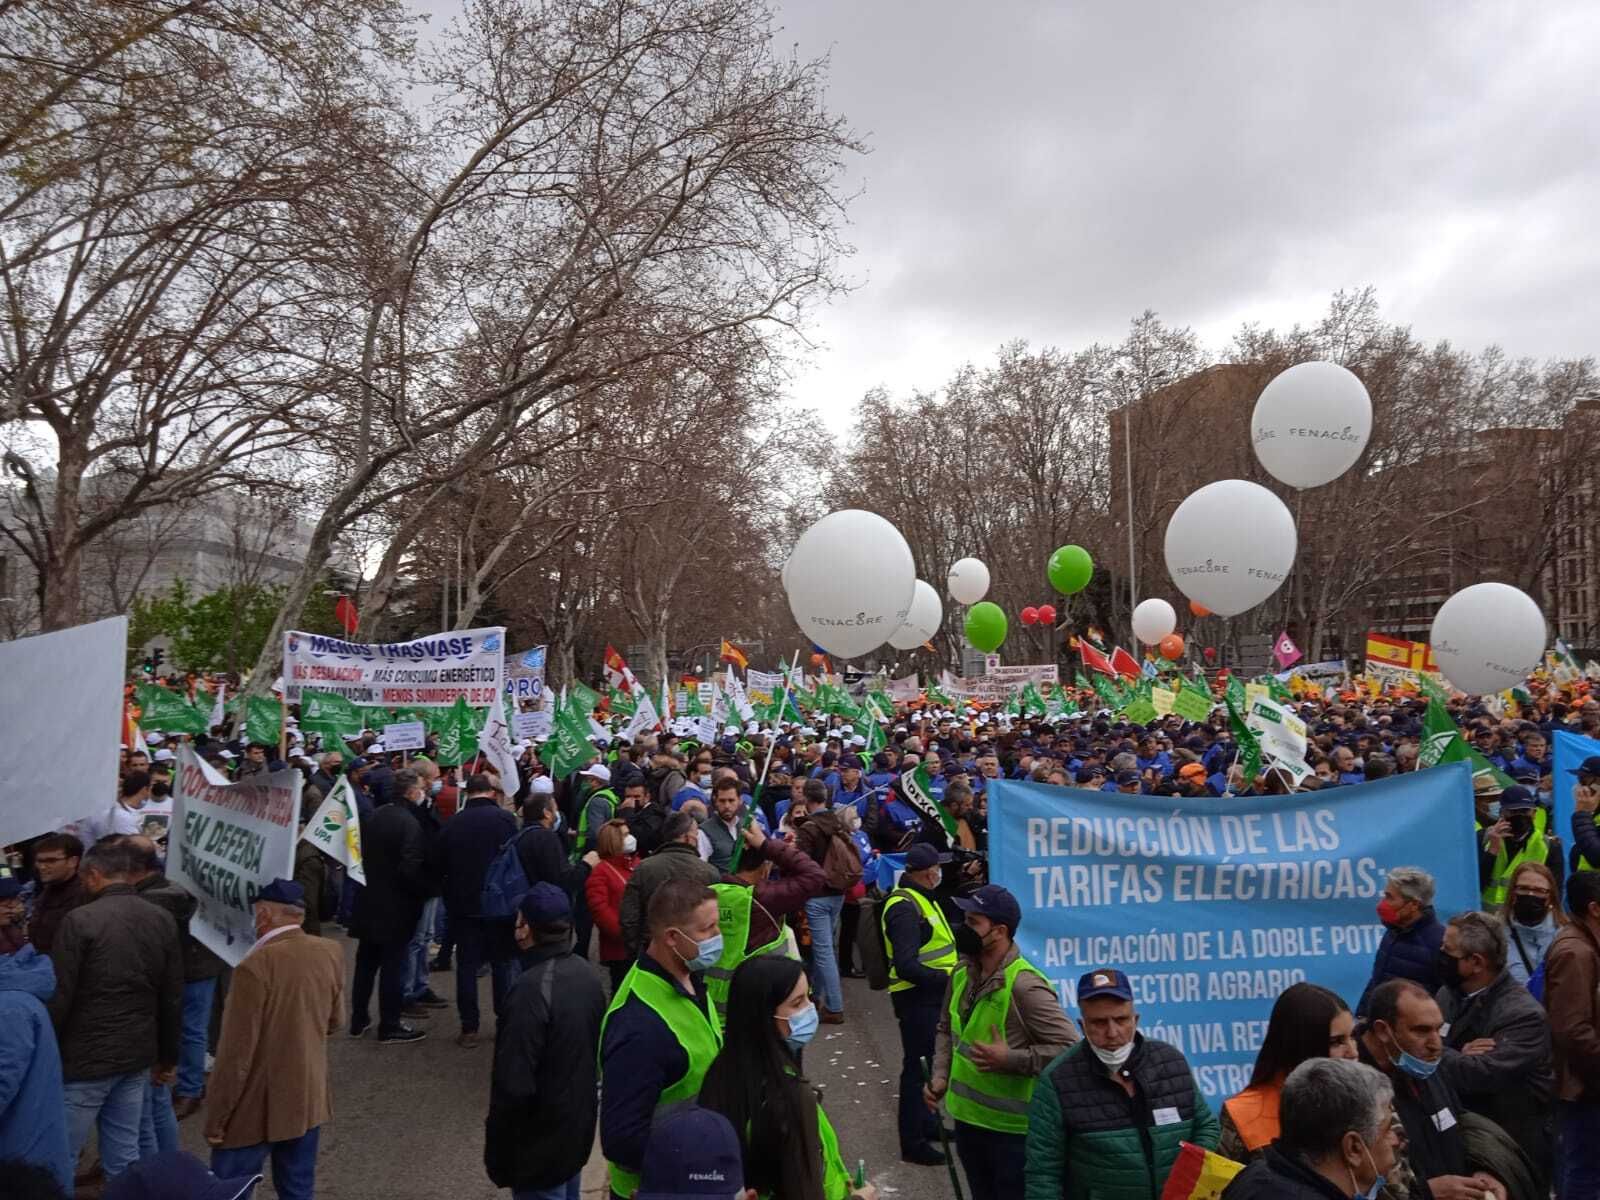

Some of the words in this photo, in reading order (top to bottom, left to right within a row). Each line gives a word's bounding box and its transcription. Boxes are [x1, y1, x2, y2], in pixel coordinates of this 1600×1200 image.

[1289, 425, 1360, 442] FENACORE
[811, 612, 883, 626] FENACORE
[440, 663, 495, 683] ENERGÉTICO
[314, 826, 332, 843] UPA
[1028, 809, 1217, 858] REDUCCIÓN
[1221, 814, 1268, 855] DE
[1272, 809, 1340, 853] LAS
[1028, 864, 1163, 909] TARIFAS
[1174, 857, 1386, 903] ELÉCTRICAS:
[1045, 928, 1177, 967] APLICACIÓN
[1183, 931, 1214, 961] DE
[1218, 930, 1248, 960] LA
[1251, 926, 1327, 959] DOBLE
[1132, 972, 1201, 1004] ECTOR
[1189, 1022, 1228, 1055] IVA
[689, 1169, 725, 1182] FENACORE
